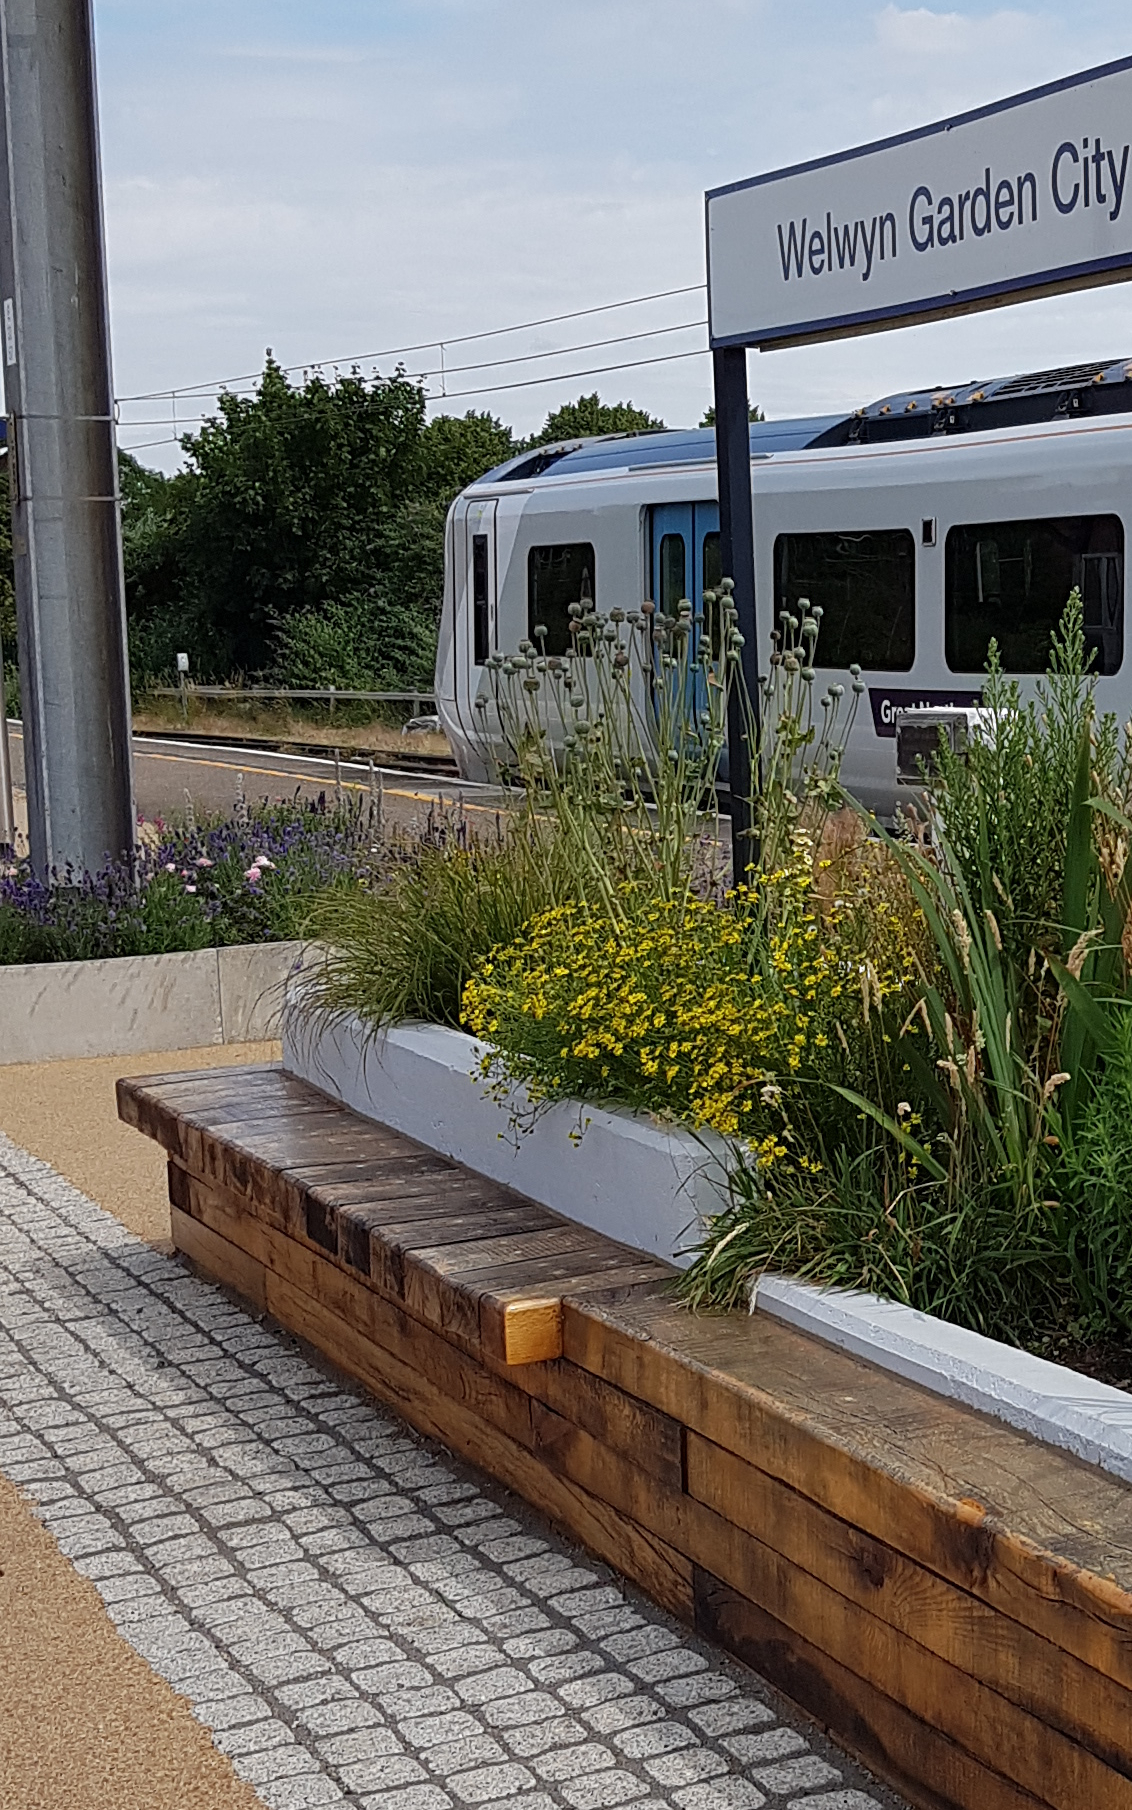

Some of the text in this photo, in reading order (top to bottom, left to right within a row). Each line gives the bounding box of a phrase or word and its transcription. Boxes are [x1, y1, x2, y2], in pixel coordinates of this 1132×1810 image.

[777, 137, 1130, 282] Welwyn Garden City
